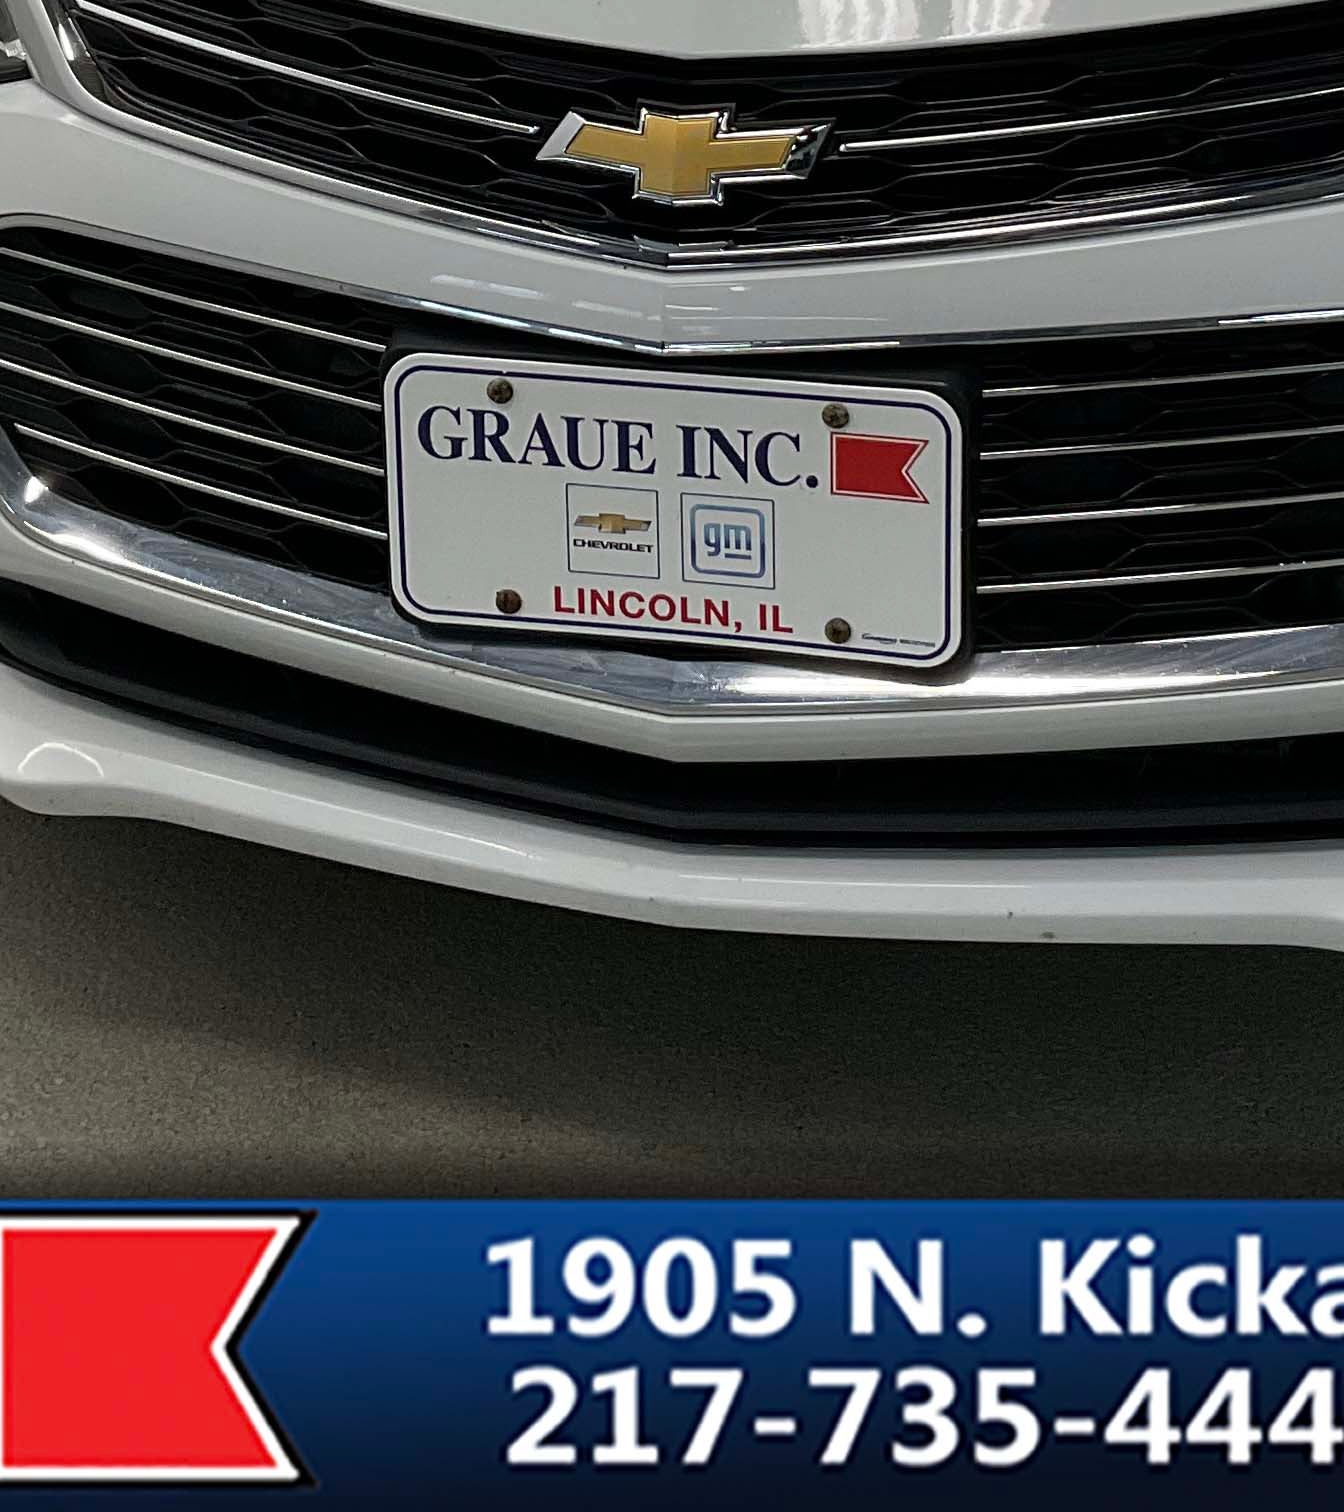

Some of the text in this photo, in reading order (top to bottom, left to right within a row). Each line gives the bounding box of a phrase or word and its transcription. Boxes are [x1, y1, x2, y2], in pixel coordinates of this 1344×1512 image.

[417, 404, 819, 489] GRAUE INC.
[572, 538, 654, 554] CHEVROLET
[703, 522, 753, 560] gm
[554, 586, 793, 634] LINCOLN, IL
